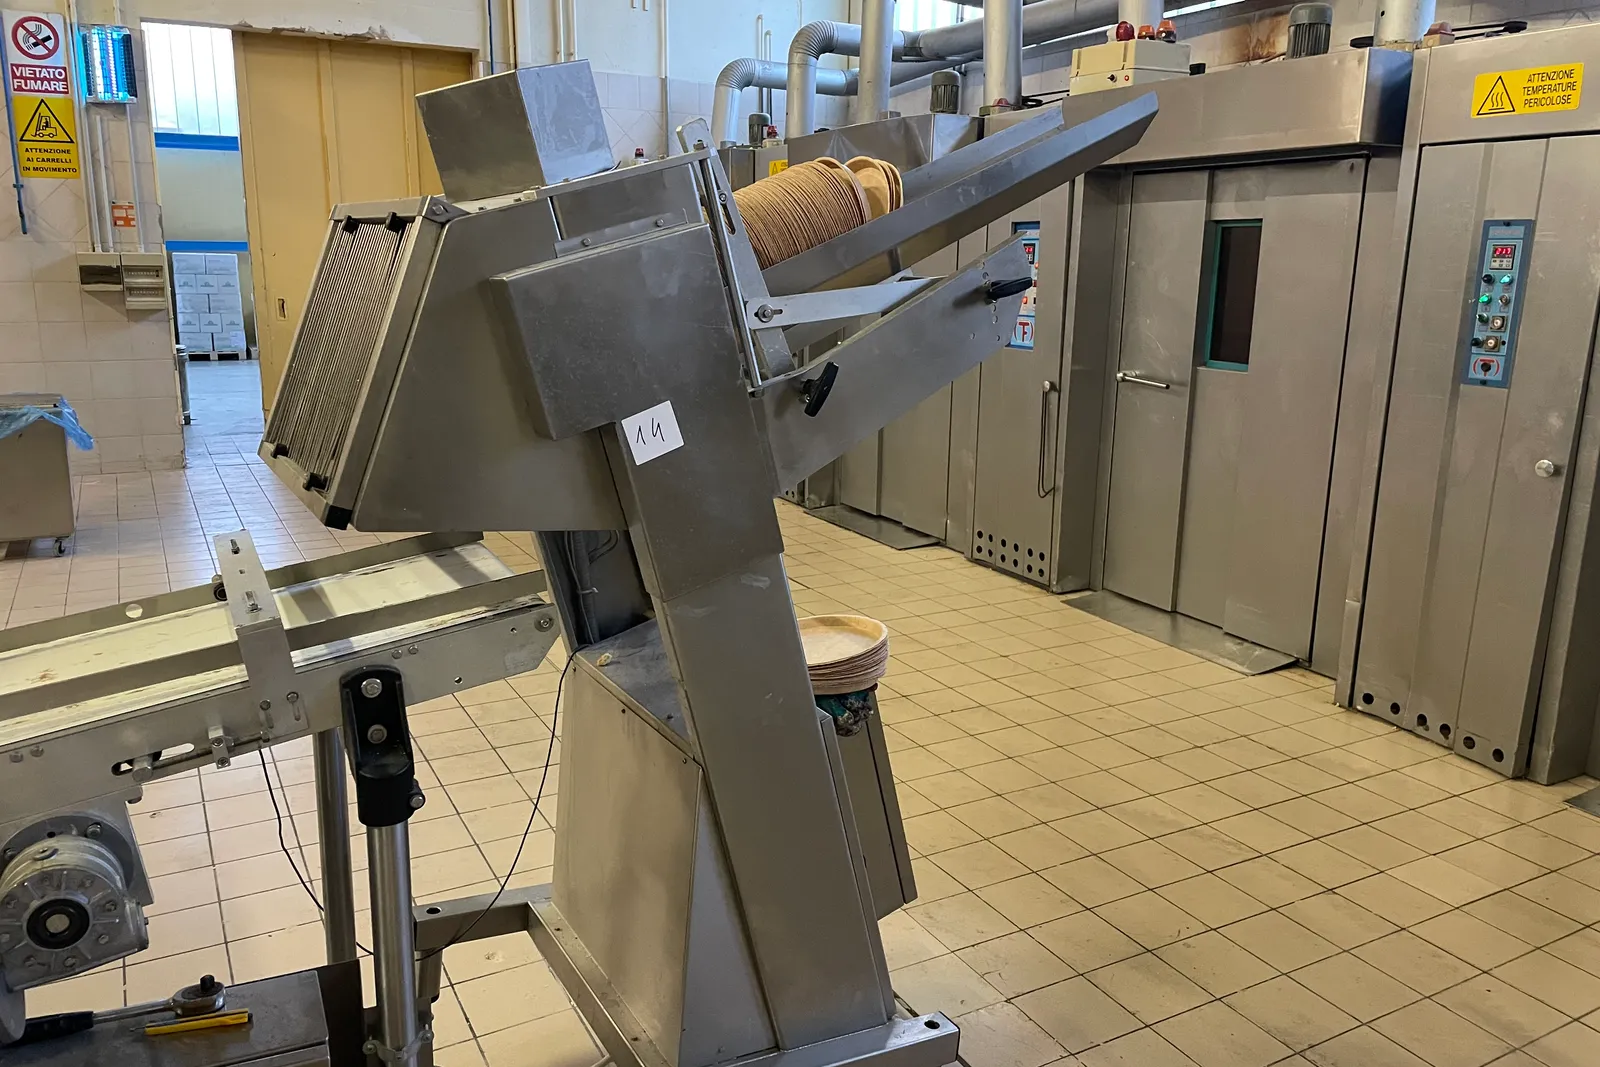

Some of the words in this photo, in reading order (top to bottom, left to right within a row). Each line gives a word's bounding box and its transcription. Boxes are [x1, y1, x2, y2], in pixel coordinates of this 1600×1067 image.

[12, 66, 65, 79] VIETATO
[1527, 69, 1575, 83] ATTENZIONE
[13, 79, 68, 92] FUMARE
[1523, 81, 1577, 96] TEMPERATURE
[1524, 94, 1572, 108] PERICOLOSE
[636, 417, 665, 446] 14
